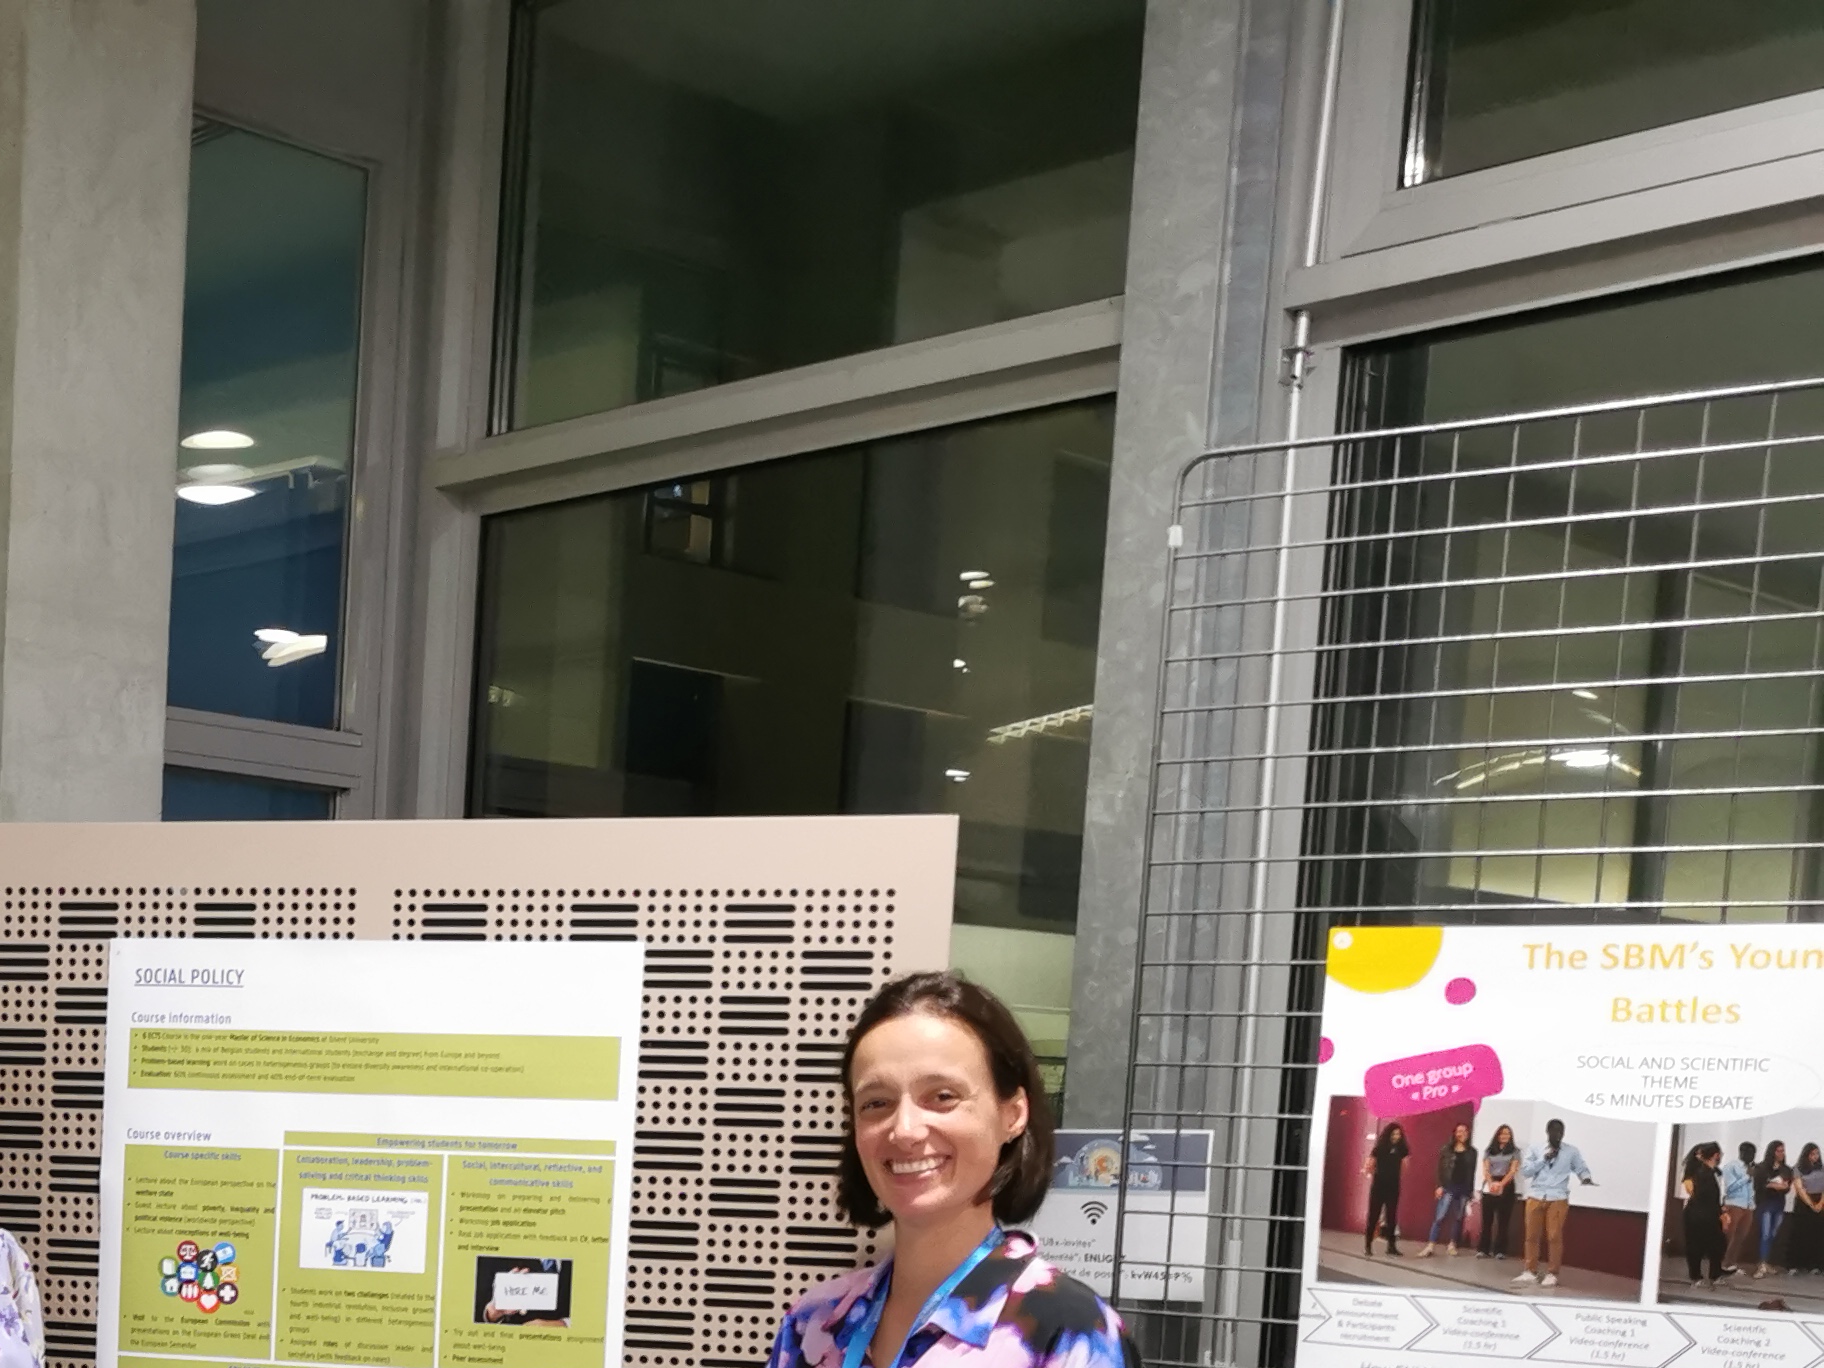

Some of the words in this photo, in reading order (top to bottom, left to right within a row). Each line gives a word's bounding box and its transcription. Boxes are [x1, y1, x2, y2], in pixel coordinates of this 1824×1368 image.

[1523, 942, 1588, 970] The
[1600, 941, 1714, 971] SBM's
[135, 968, 185, 984] SOCIAL
[191, 969, 245, 985] POLICY
[1611, 996, 1741, 1025] Battles
[131, 1011, 166, 1024] Course
[168, 1012, 232, 1025] information
[1577, 1055, 1634, 1070] SOCIAL
[1638, 1057, 1676, 1071] AND
[1680, 1057, 1770, 1073] SCIENTIFIC
[1391, 1072, 1425, 1089] One
[1426, 1061, 1474, 1085] group
[1641, 1075, 1698, 1090] THEME
[1422, 1085, 1448, 1100] Pro
[1585, 1093, 1605, 1106] 45
[1610, 1094, 1684, 1109] MINUTES
[1689, 1095, 1753, 1110] DEBATE
[127, 1128, 161, 1140] Course
[164, 1130, 212, 1141] overview
[376, 1137, 425, 1149] Empowering
[427, 1139, 462, 1148] students
[464, 1140, 476, 1149] for
[478, 1141, 518, 1150] tomorrow
[164, 1150, 189, 1159] Course
[191, 1151, 219, 1161] specific
[221, 1152, 241, 1161] skills
[296, 1155, 350, 1166] Collaboration,
[352, 1157, 395, 1168] leadership,
[587, 1165, 602, 1174] and
[299, 1171, 326, 1181] solving
[329, 1172, 343, 1180] and
[345, 1173, 371, 1181] critical
[374, 1174, 406, 1184] thinking
[407, 1175, 428, 1184] skills
[489, 1178, 550, 1188] communicative
[552, 1179, 573, 1188] skills
[1575, 1312, 1603, 1323] Public
[1605, 1314, 1648, 1328] Speaking
[1584, 1325, 1627, 1338] Coaching
[1723, 1323, 1767, 1335] Scientific
[1569, 1336, 1650, 1351] Video-conference
[1717, 1335, 1762, 1348] Coaching
[1701, 1346, 1786, 1361] Video-conference
